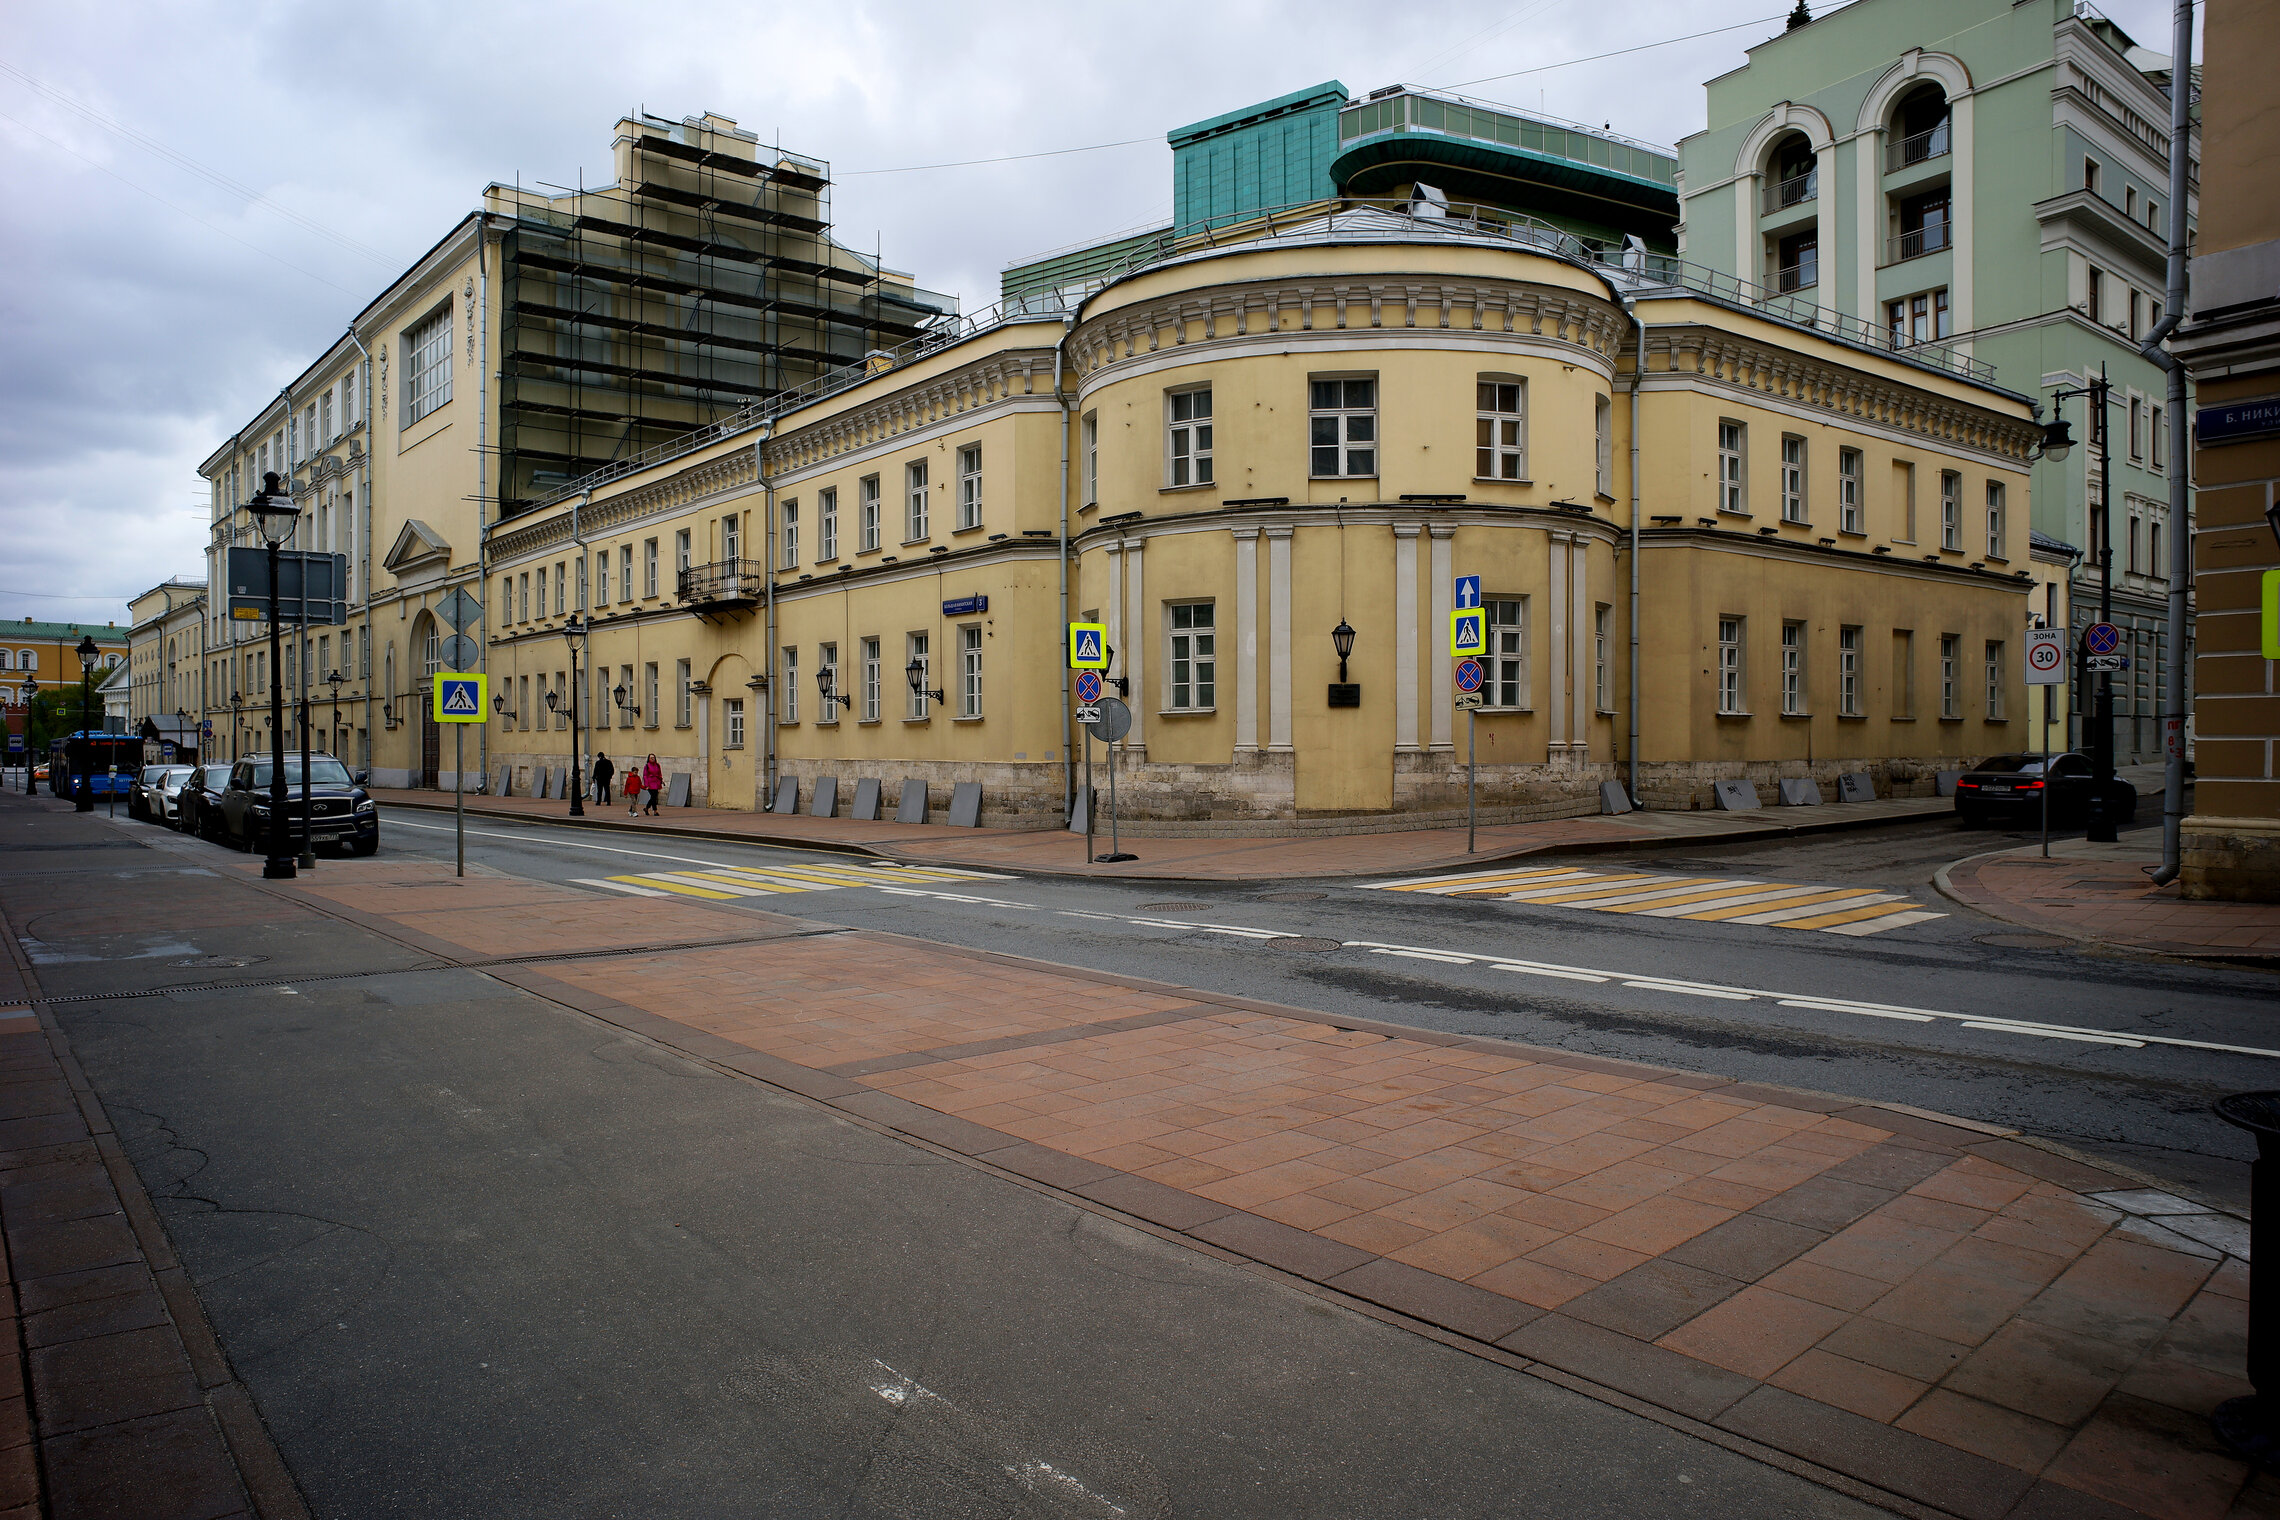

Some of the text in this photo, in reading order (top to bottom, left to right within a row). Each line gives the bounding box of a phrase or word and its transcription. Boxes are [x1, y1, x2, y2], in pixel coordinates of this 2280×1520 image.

[2225, 413, 2238, 423] Б.
[2033, 632, 2057, 640] ЗОНА
[2036, 651, 2053, 663] 30
